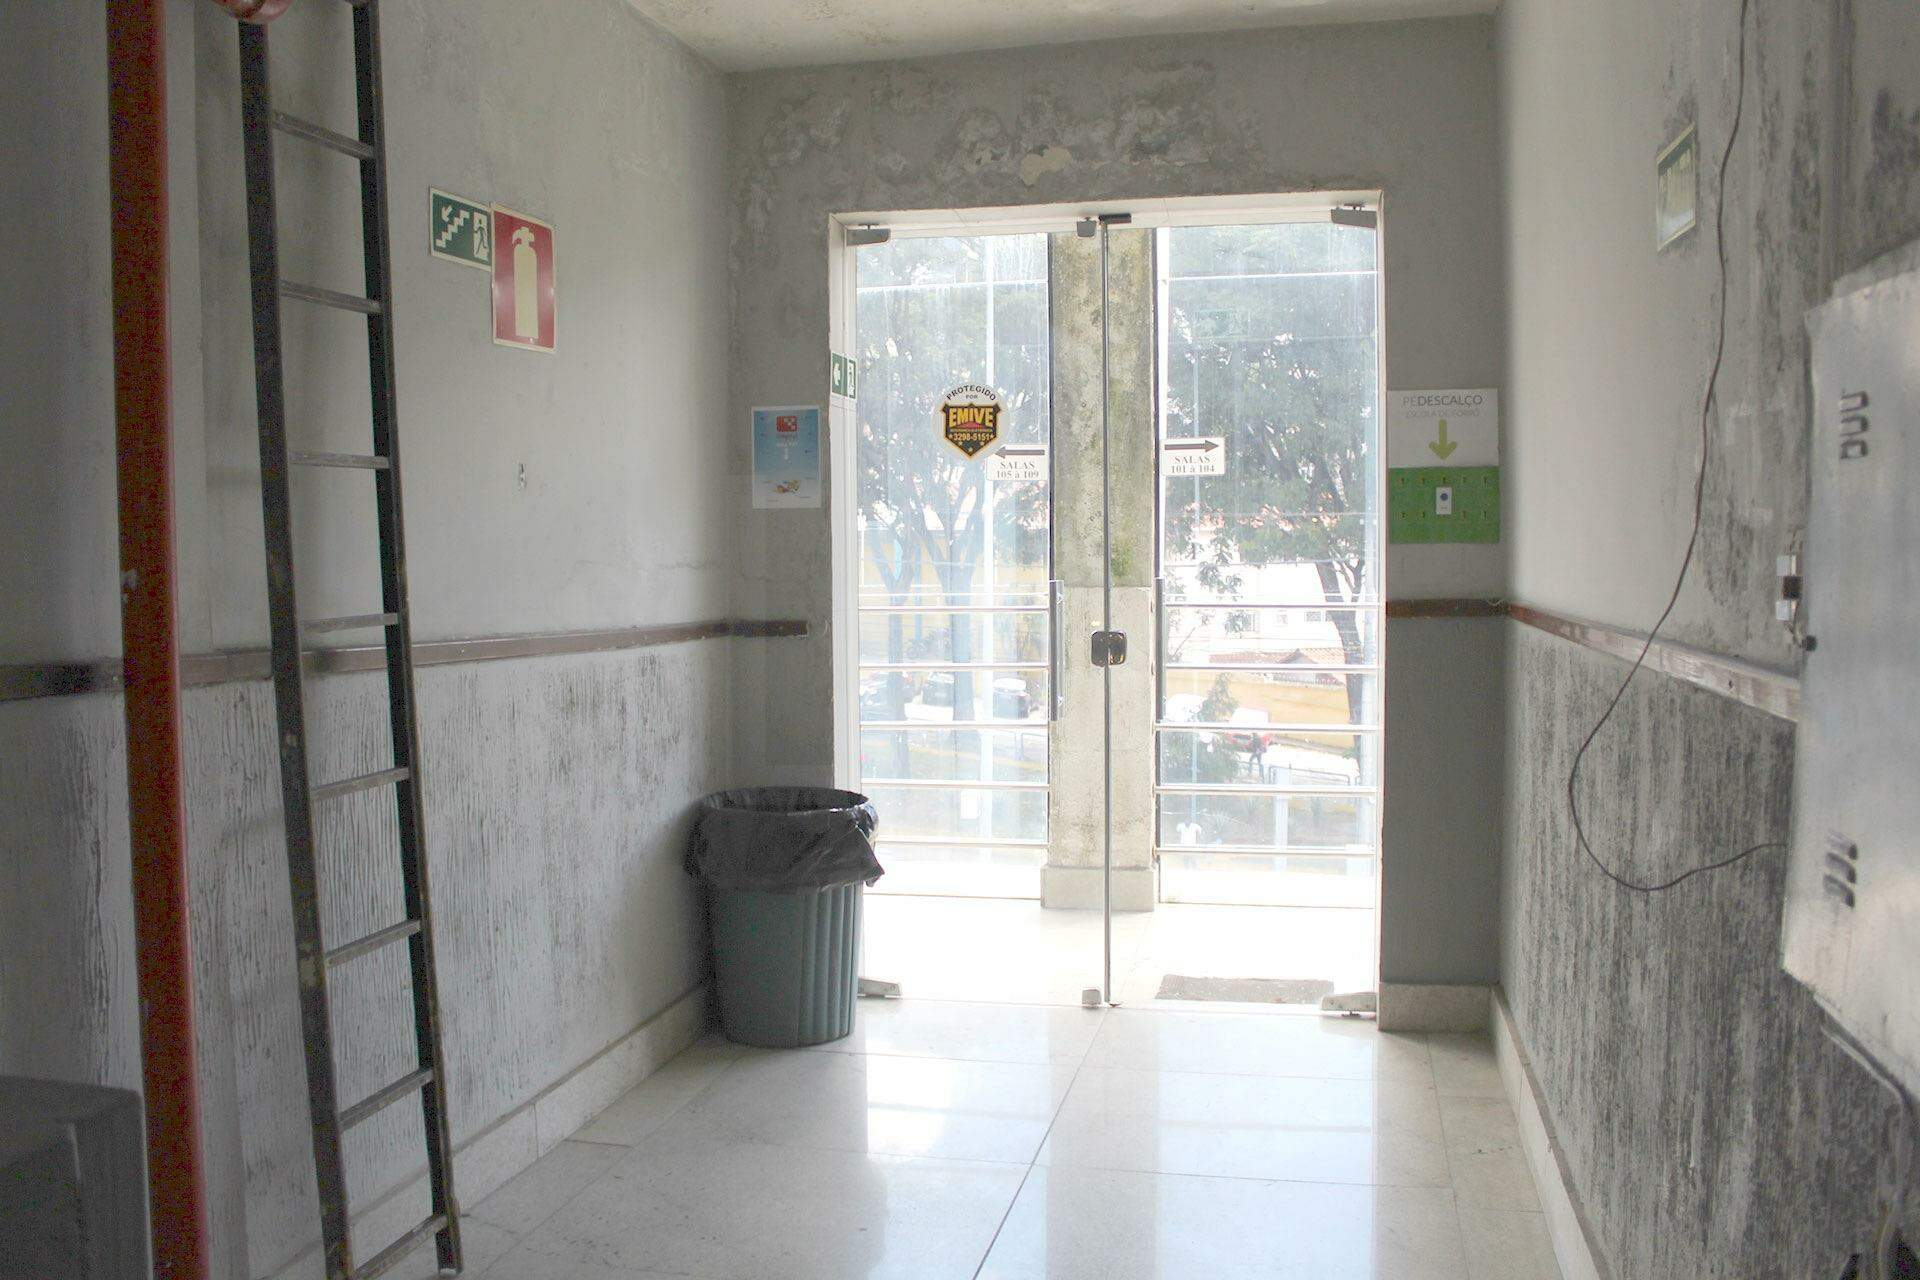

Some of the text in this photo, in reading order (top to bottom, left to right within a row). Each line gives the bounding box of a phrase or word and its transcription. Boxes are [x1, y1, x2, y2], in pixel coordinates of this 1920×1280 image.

[946, 385, 996, 400] PROTEGIDO
[949, 407, 993, 427] EMIVE
[1174, 455, 1210, 464] SALAS
[1000, 461, 1035, 470] SALAS
[1171, 464, 1186, 473] 101
[1200, 464, 1215, 473] 104
[1024, 470, 1039, 478] 109
